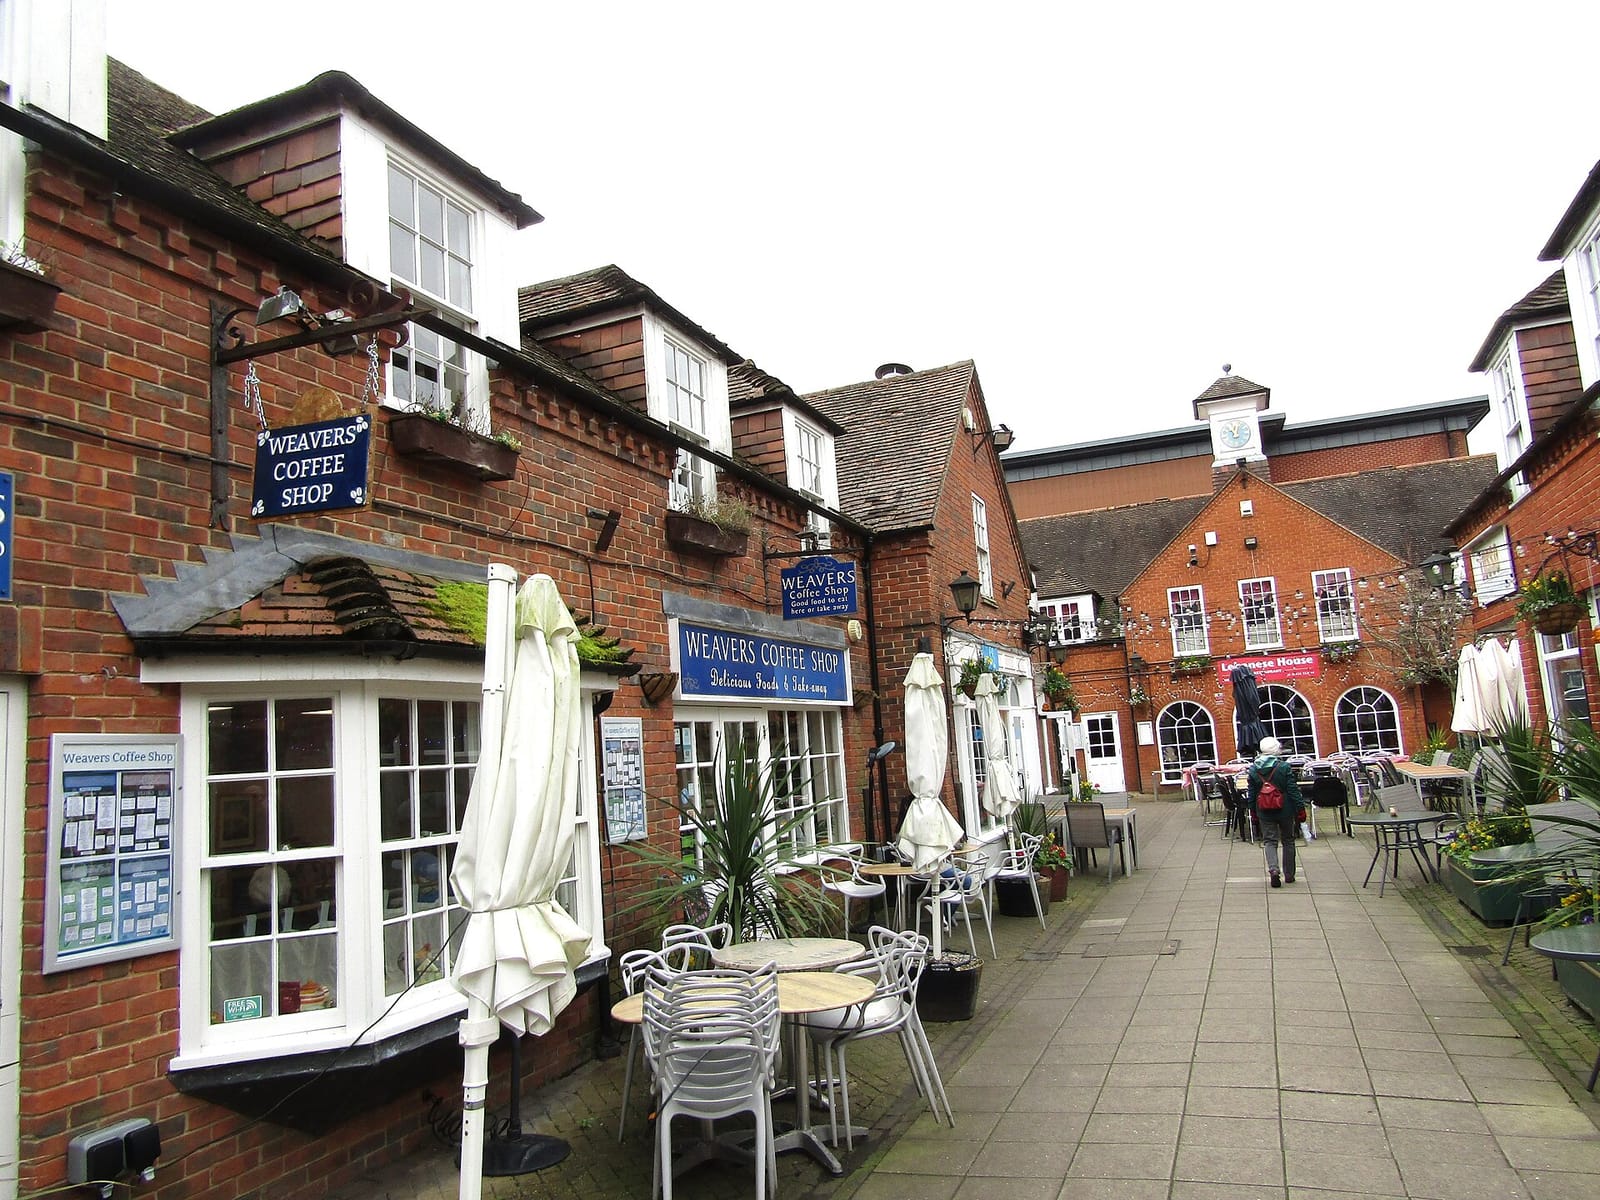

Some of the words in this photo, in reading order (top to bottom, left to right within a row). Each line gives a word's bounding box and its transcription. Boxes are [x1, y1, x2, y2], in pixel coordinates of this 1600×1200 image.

[268, 425, 356, 456] WEAVERS
[273, 453, 345, 481] COFFEE
[281, 483, 334, 508] SHOP
[781, 570, 855, 590] WEAVERS
[789, 588, 820, 600] Coffee
[824, 586, 849, 597] Shop
[791, 599, 809, 607] Good
[685, 630, 756, 664] WEAVERS
[760, 642, 806, 670] COFFEE
[811, 650, 839, 674] SHOP
[1276, 656, 1313, 667] House
[710, 667, 752, 689] Delicious
[755, 672, 779, 691] Foods
[783, 674, 789, 692] &
[792, 674, 828, 698] Take-away
[63, 752, 111, 763] Weavers
[112, 751, 146, 762] Coffee
[147, 751, 173, 763] Shop
[228, 1000, 246, 1008] FREE
